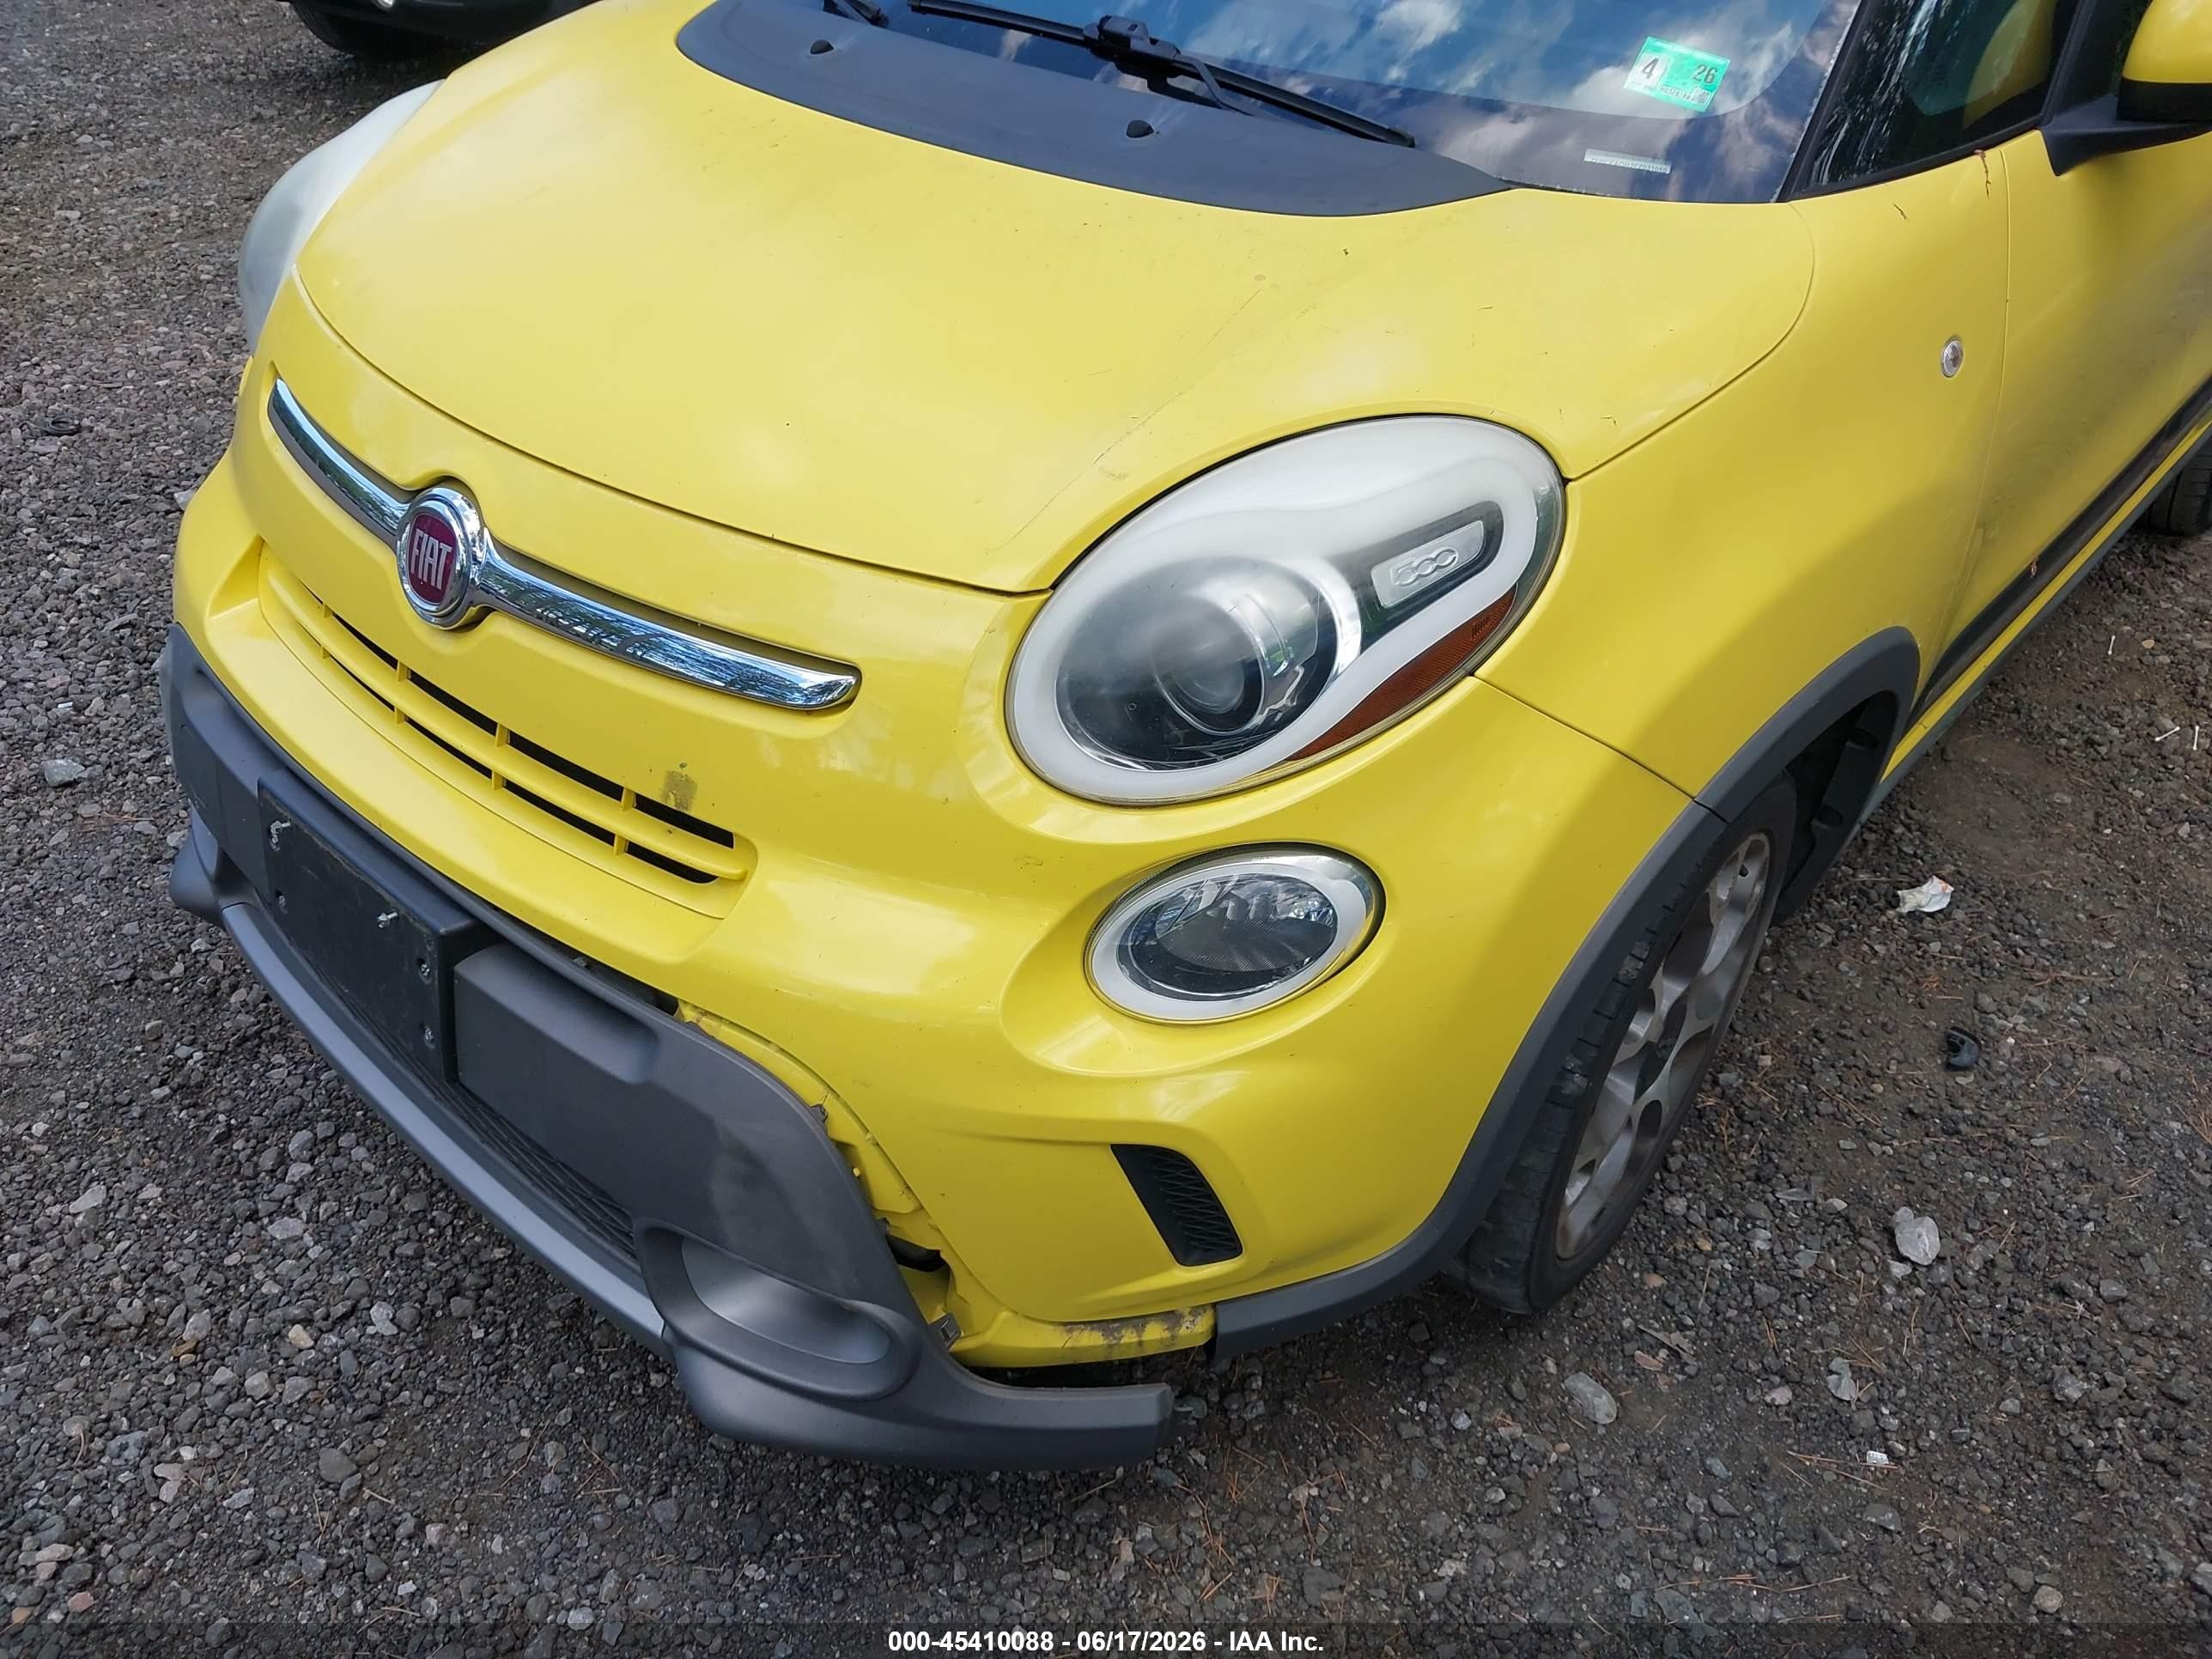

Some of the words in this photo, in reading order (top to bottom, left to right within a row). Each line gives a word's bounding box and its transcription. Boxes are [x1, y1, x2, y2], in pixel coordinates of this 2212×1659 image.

[1641, 58, 1659, 79] 4
[1692, 64, 1717, 84] 26
[410, 528, 453, 591] FIAT
[1390, 546, 1459, 588] 500
